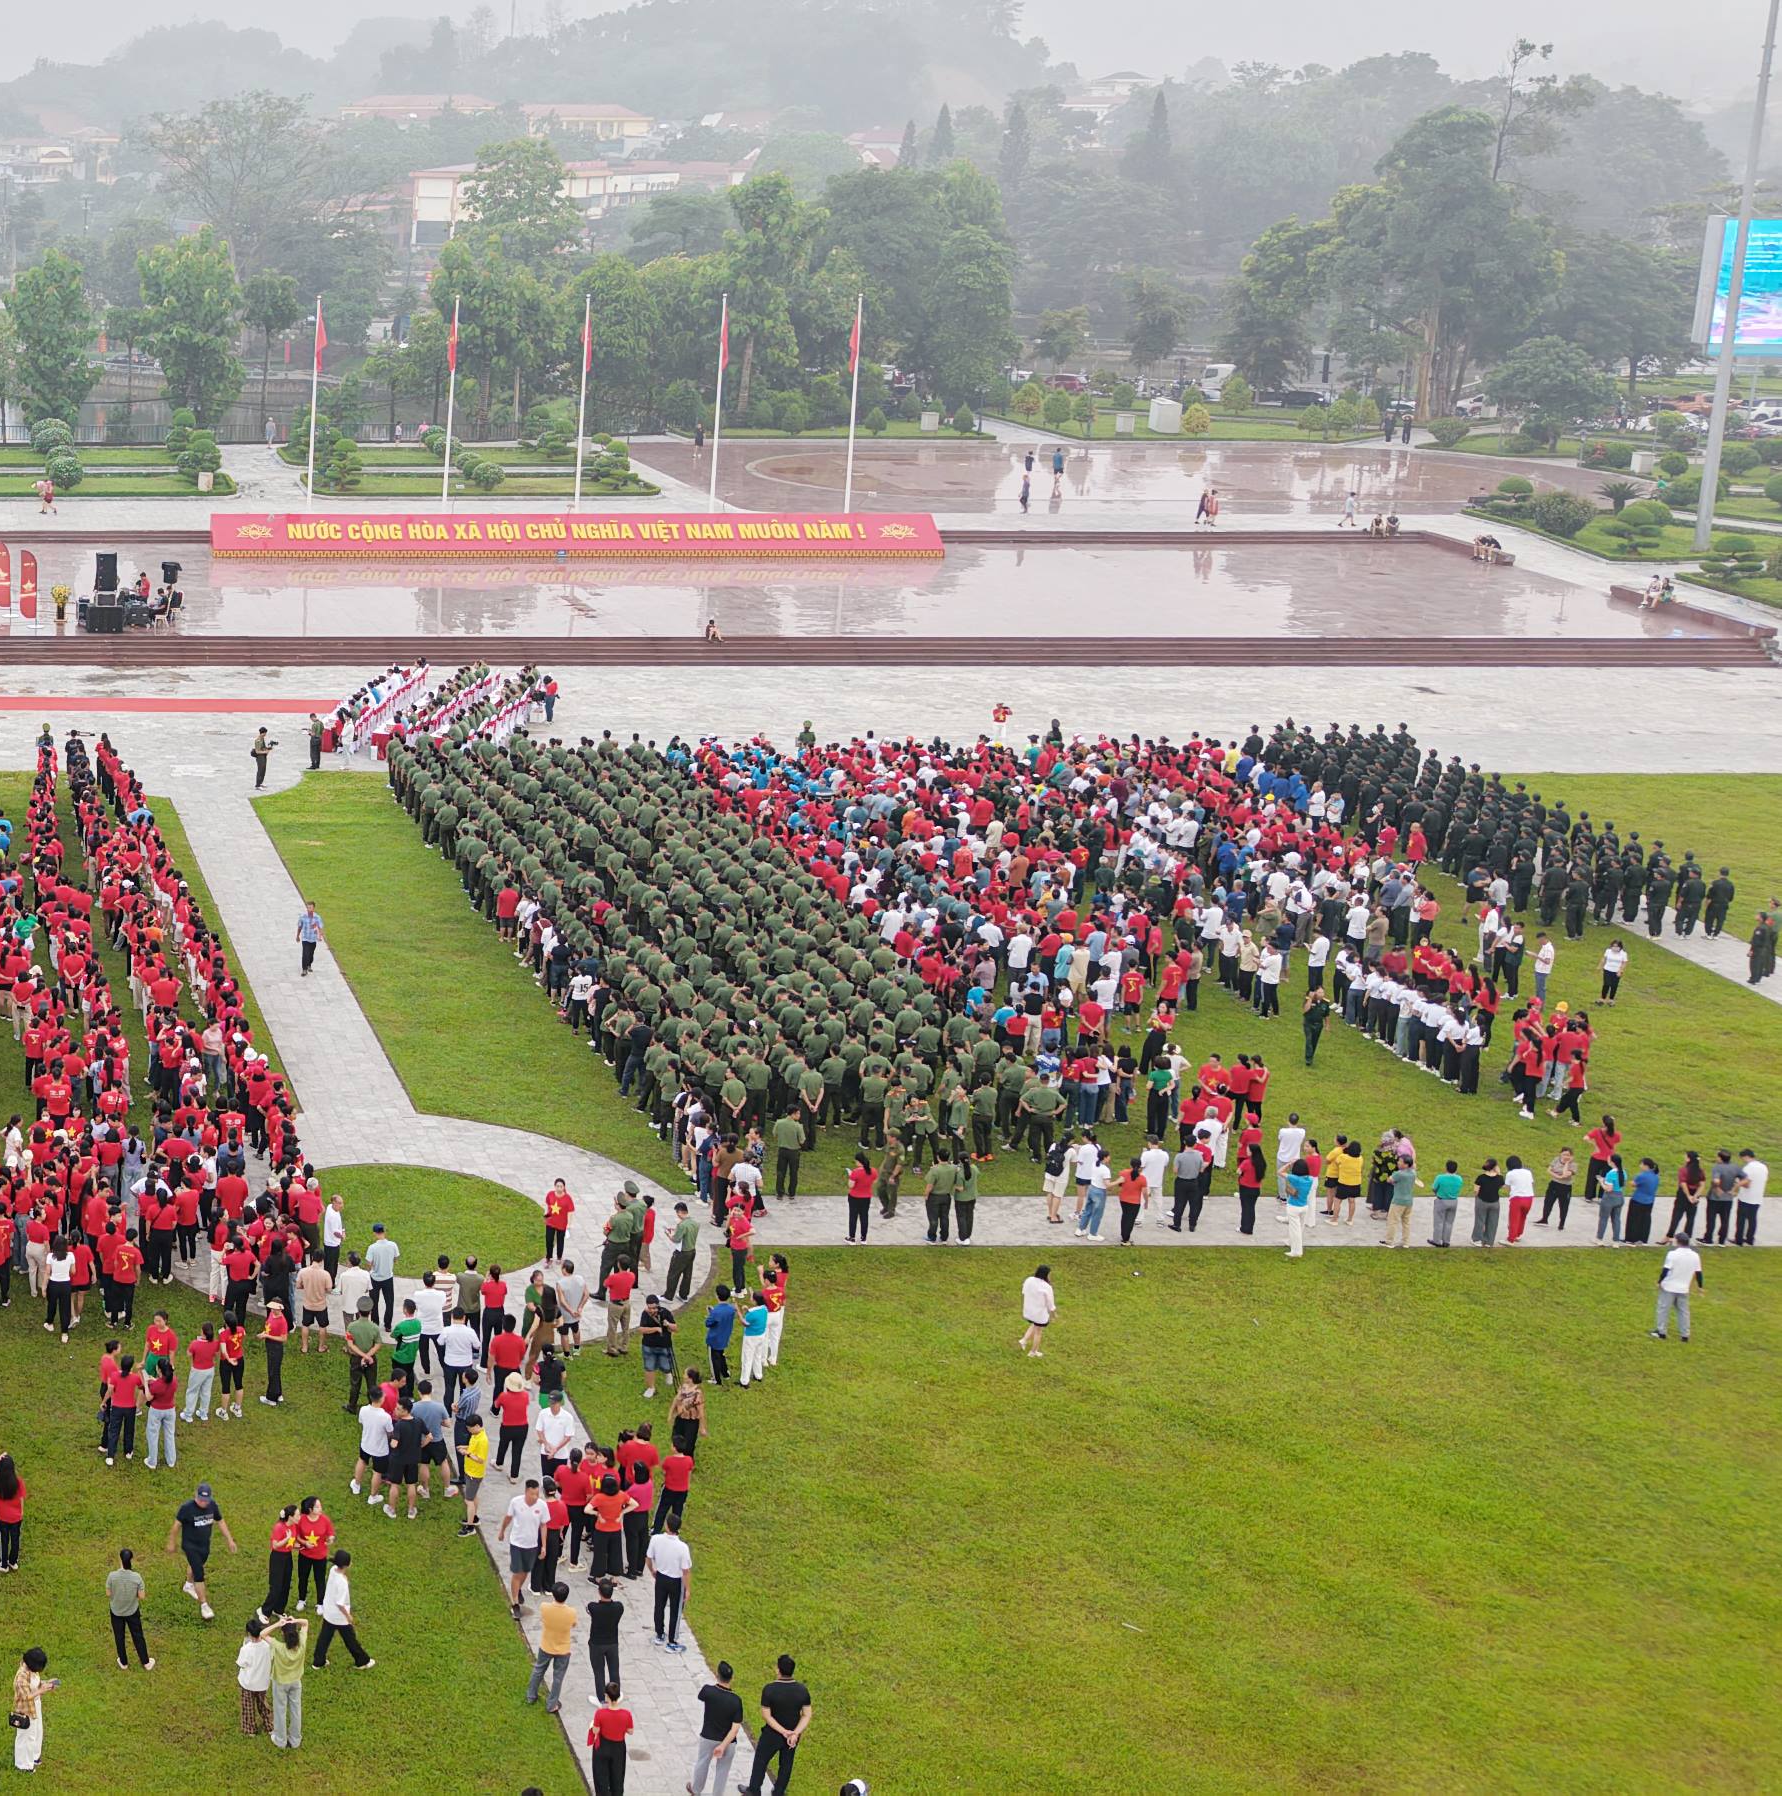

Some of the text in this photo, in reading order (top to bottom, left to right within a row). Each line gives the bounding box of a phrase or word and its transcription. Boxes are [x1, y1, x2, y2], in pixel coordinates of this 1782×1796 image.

[287, 517, 867, 543] NƯỚC CỘNG HÒA XÃ HỘI CHỦ NGHĨA VIỆT NAM MUÔN NĂM !
